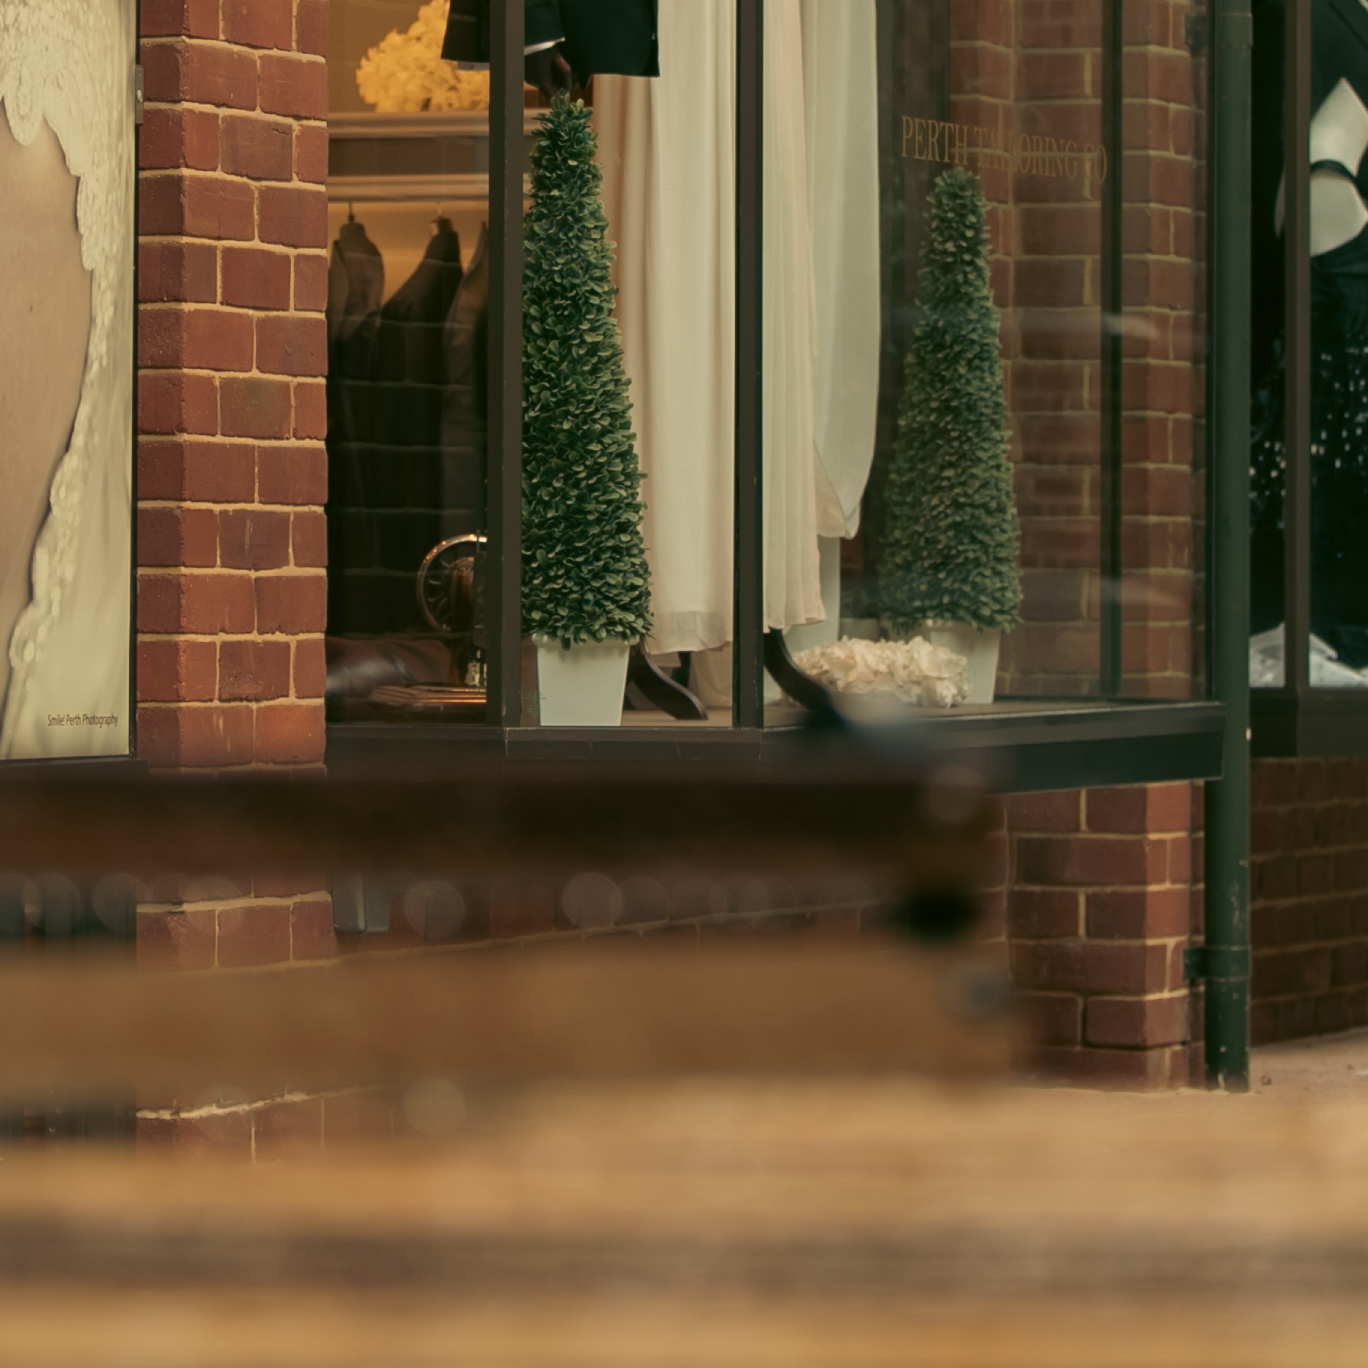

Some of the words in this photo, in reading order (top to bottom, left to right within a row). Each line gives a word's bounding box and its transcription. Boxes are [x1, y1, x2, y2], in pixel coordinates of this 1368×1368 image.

[900, 115, 969, 166] PERTH
[973, 126, 1078, 181] TAILORING
[47, 714, 65, 727] Smile!
[66, 714, 82, 726] Perth
[82, 713, 119, 728] Photography
